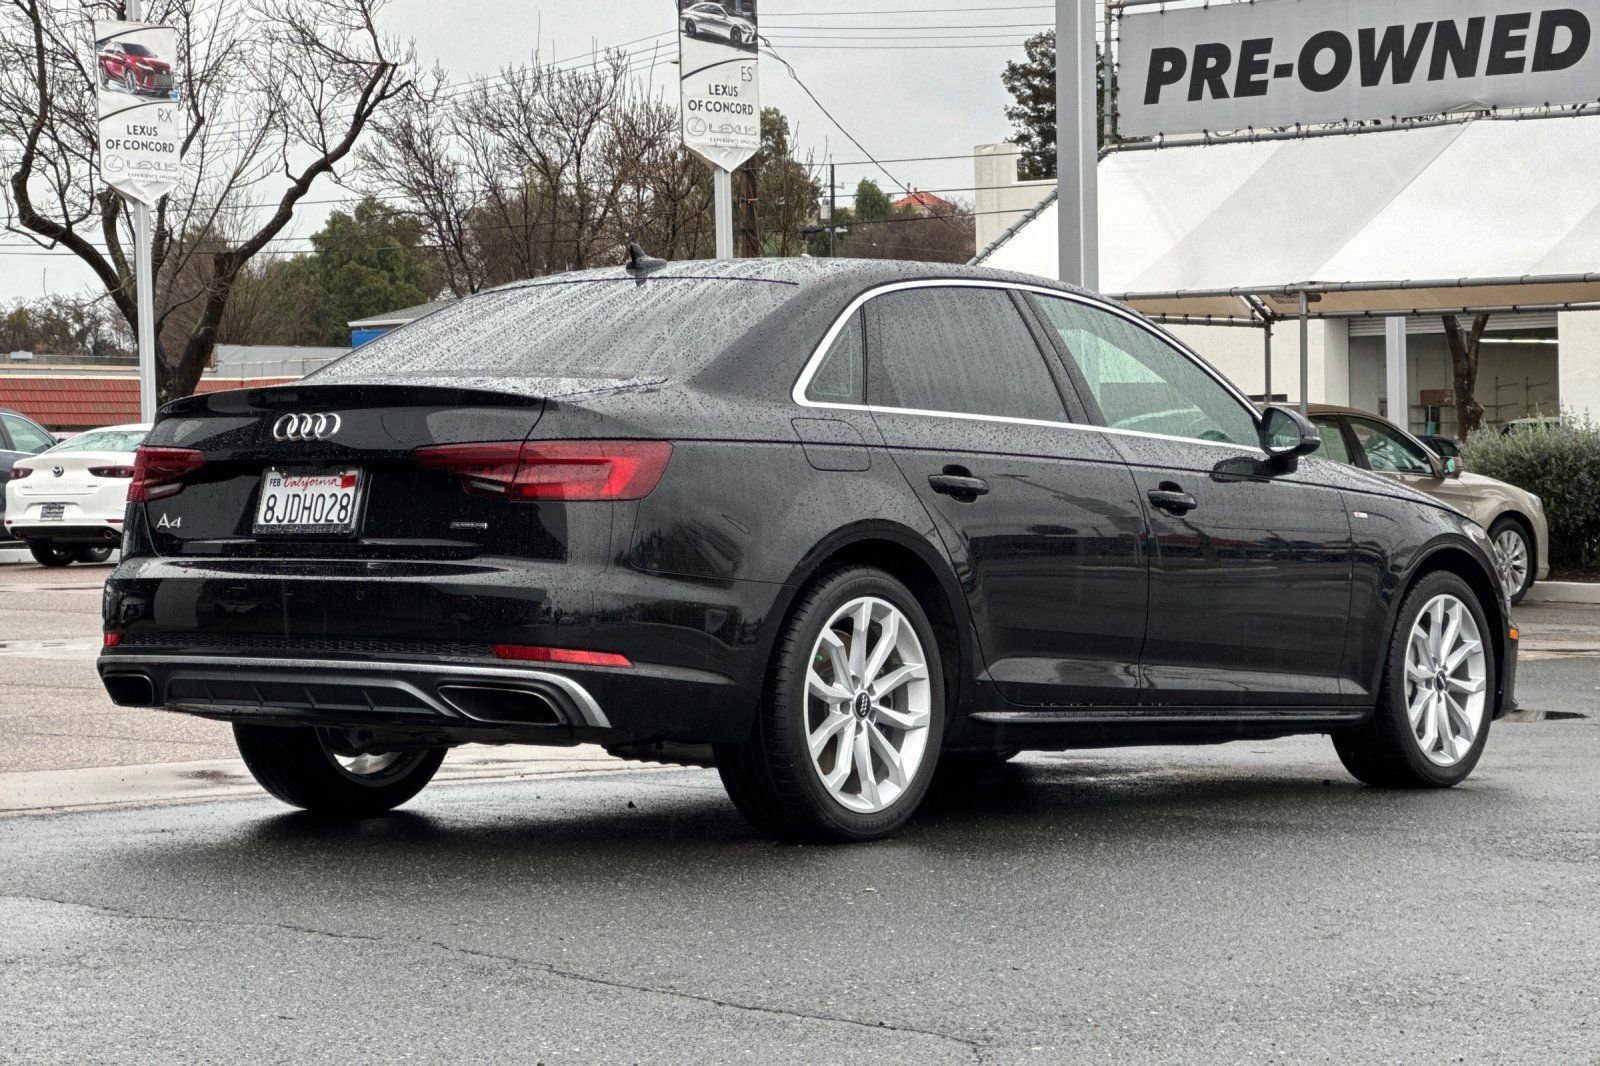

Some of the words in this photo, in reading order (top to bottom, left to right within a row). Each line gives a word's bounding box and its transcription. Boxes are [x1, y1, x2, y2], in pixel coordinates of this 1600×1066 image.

[1143, 8, 1591, 105] PRE-OWNED
[741, 65, 753, 82] ES
[708, 84, 739, 97] LEXUS
[688, 99, 703, 111] OF
[705, 101, 754, 115] CONCORD
[157, 108, 173, 123] RX
[127, 124, 158, 137] LEXUS
[105, 139, 121, 150] OF
[123, 139, 175, 153] CONCORD
[269, 478, 281, 487] FEB
[283, 477, 337, 491] California
[263, 492, 351, 524] 8JDH028
[157, 512, 181, 529] A4
